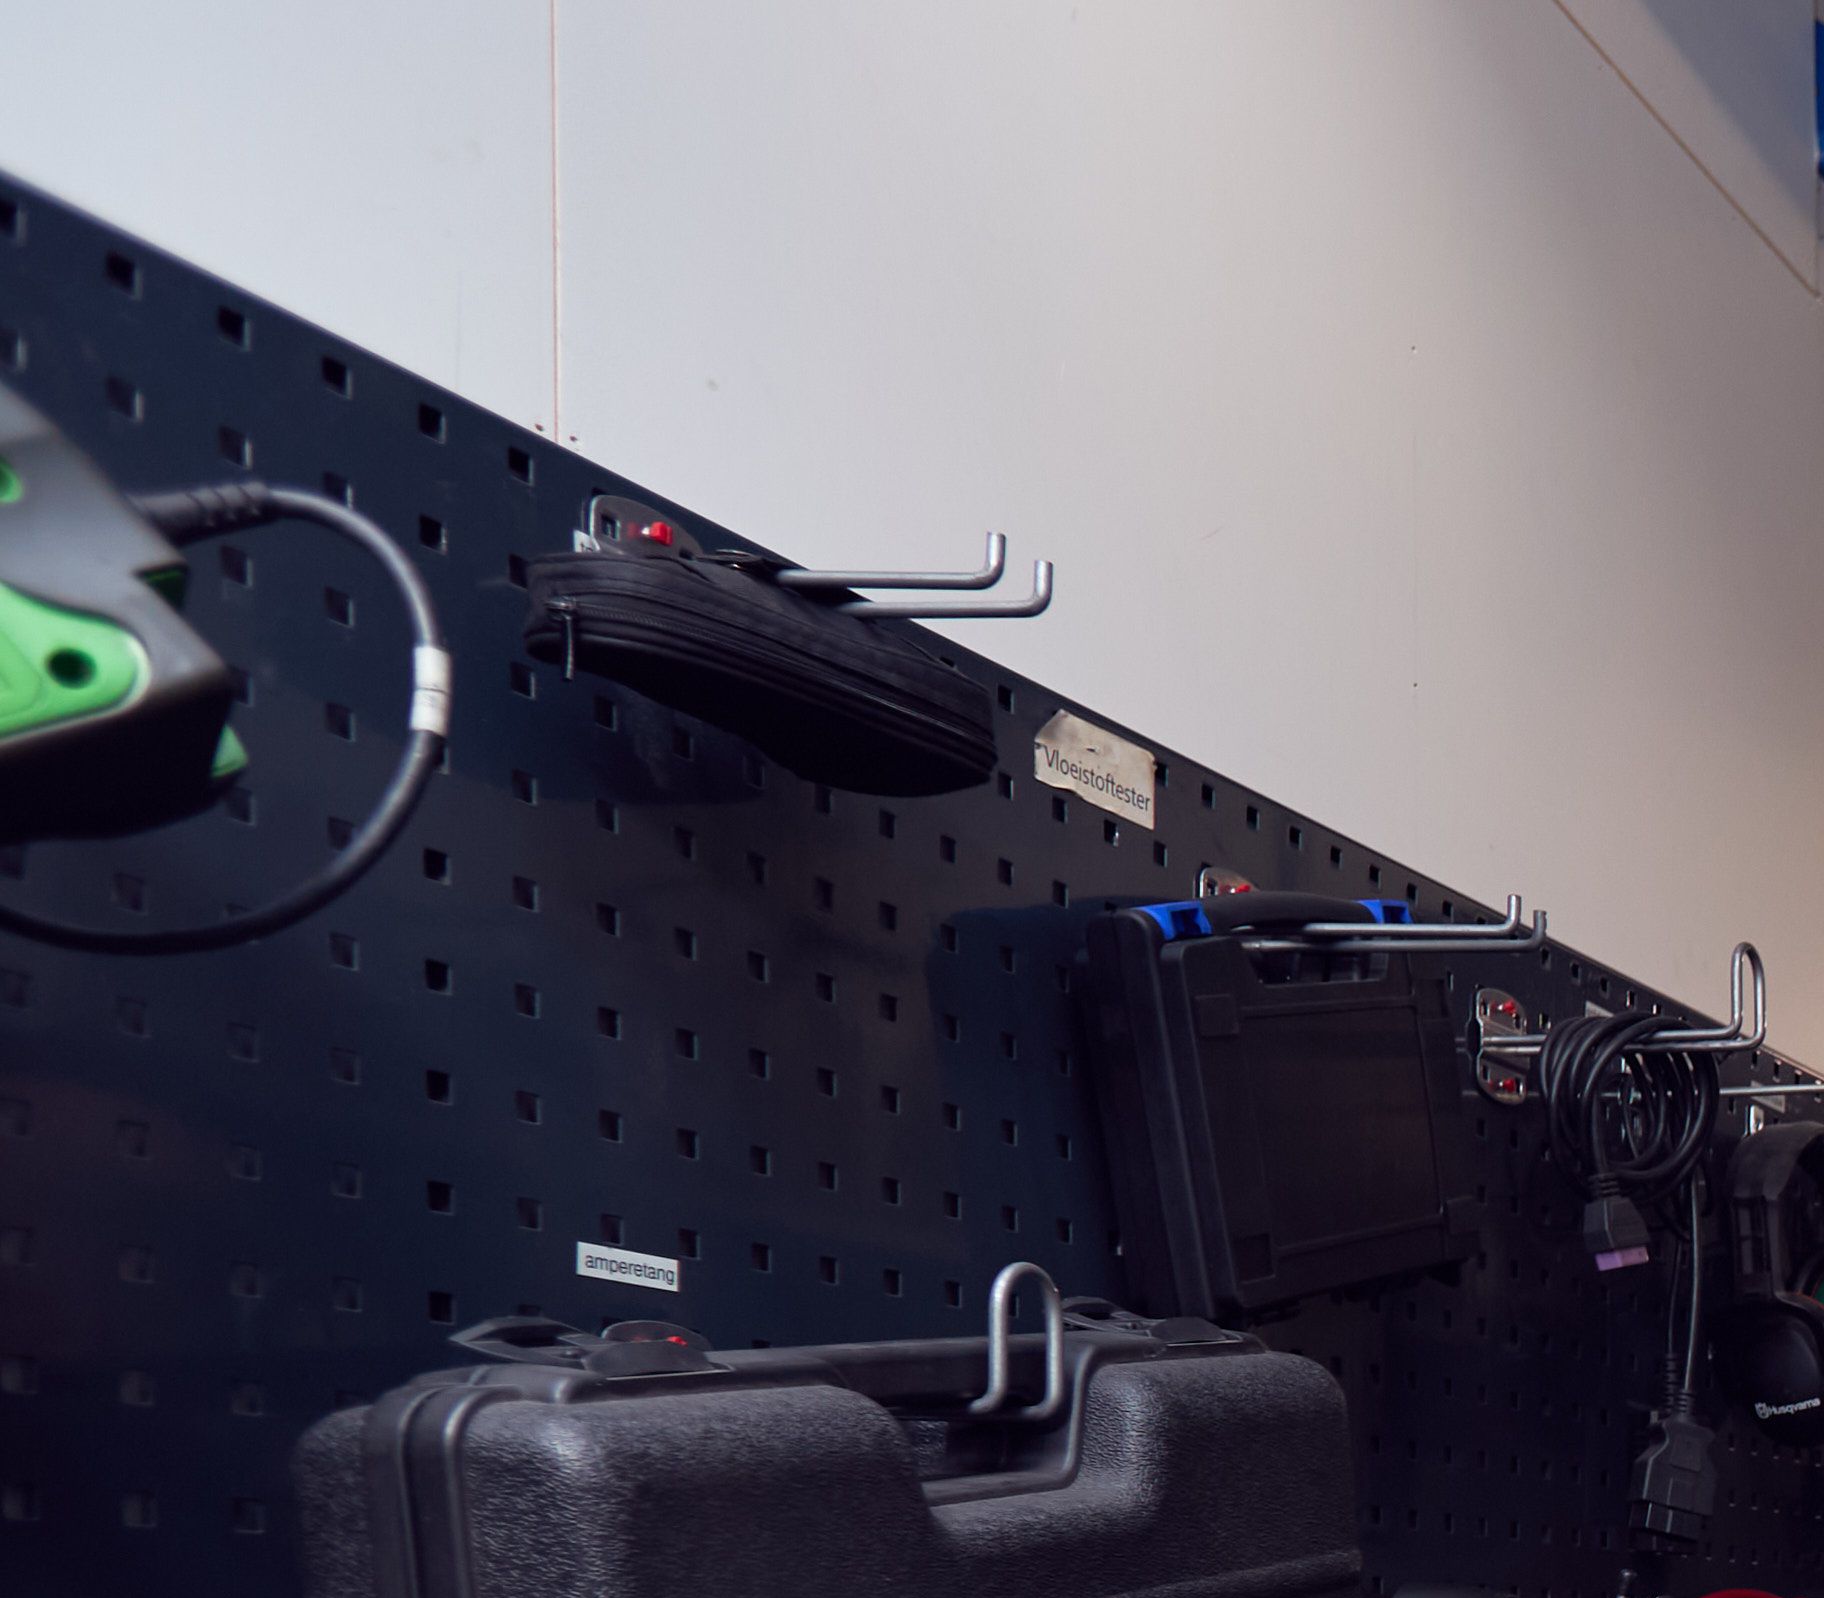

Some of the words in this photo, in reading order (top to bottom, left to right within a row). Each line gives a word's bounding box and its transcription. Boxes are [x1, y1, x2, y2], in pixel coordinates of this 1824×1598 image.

[1043, 745, 1151, 811] Vloeistoftester
[585, 1253, 675, 1286] amperetang
[1768, 1397, 1822, 1416] Husqvarna
